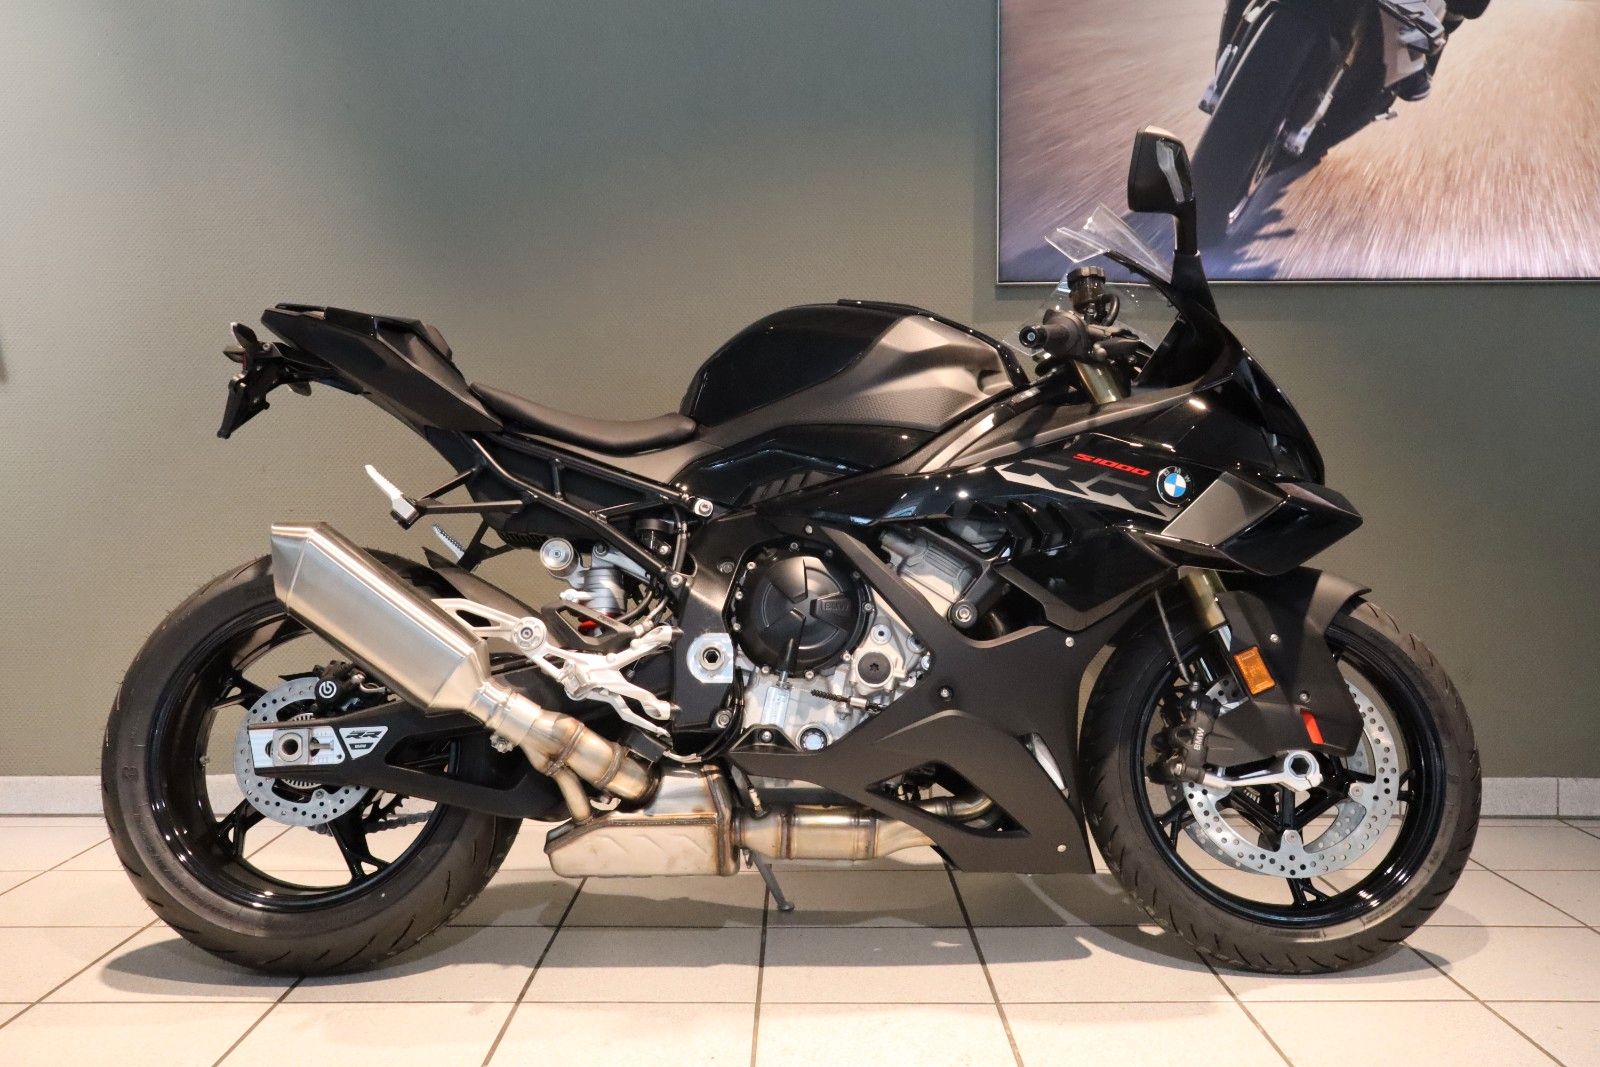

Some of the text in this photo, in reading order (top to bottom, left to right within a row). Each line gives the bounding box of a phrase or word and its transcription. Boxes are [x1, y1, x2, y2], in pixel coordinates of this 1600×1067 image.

[1073, 453, 1151, 477] S1000
[1163, 466, 1191, 483] BMW
[1194, 727, 1204, 751] BMW
